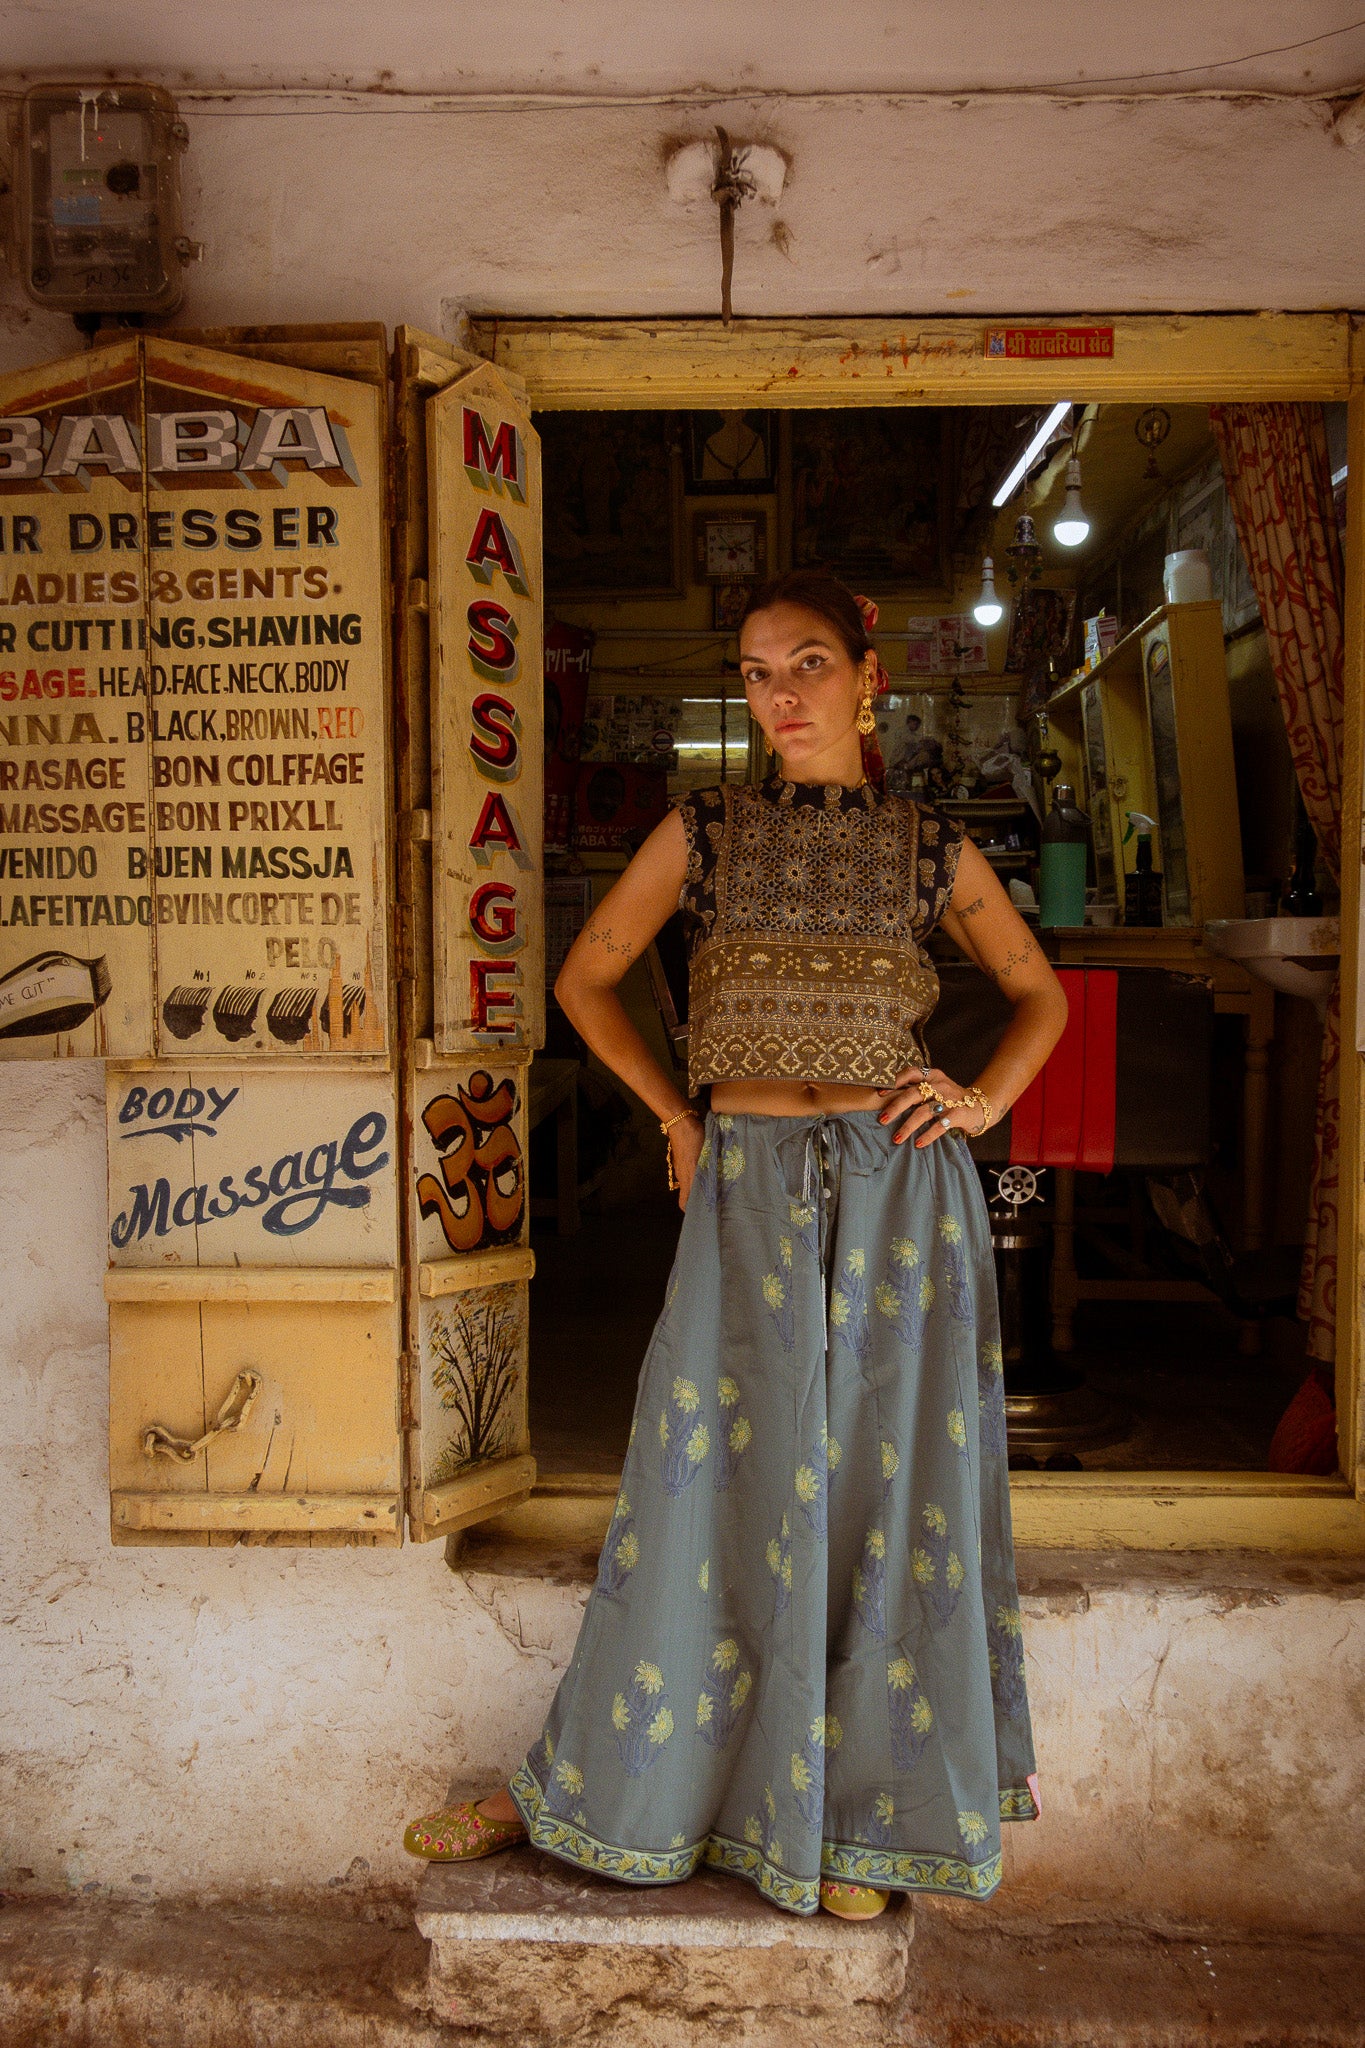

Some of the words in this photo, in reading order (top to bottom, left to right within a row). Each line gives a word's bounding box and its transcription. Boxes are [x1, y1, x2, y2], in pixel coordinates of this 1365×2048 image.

[1008, 331, 1026, 355] श्री
[69, 506, 339, 552] DRESSER
[463, 406, 530, 1045] MASSAGE
[153, 755, 222, 788] BON
[227, 753, 364, 787] COLFFAGE
[0, 802, 146, 834] MASSAGE
[156, 801, 222, 832] BON
[228, 800, 343, 832] PRIXLL
[128, 847, 213, 879] BUEN
[221, 846, 354, 879] MASSJA
[321, 892, 362, 925] DE
[266, 936, 338, 968] PELO
[119, 1086, 241, 1124] BODY
[110, 1110, 390, 1249] Massage
